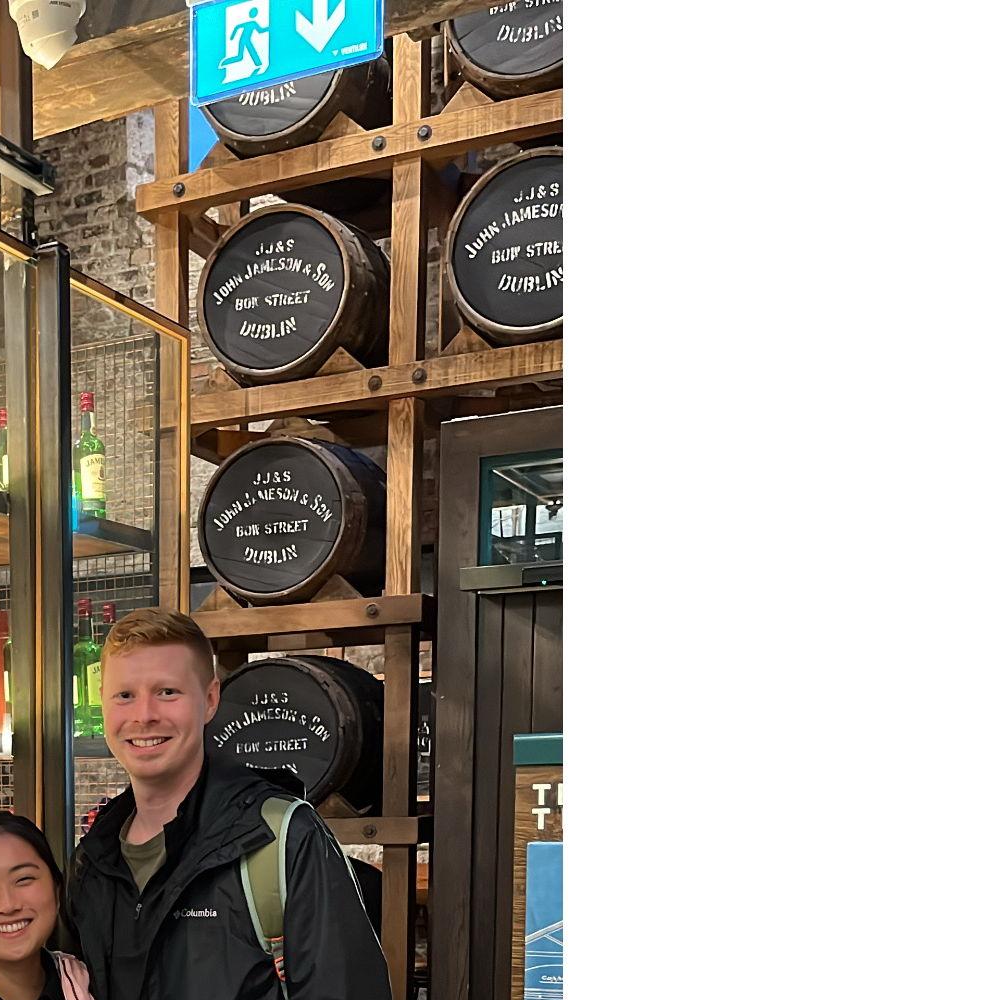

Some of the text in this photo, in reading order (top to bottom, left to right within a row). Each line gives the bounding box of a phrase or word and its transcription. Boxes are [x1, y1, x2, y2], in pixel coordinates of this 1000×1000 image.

[238, 81, 297, 106] DUBLIN
[491, 245, 521, 264] BOW
[212, 257, 335, 305] JOHN JAMESON & SON
[264, 289, 311, 307] STREET
[239, 316, 297, 339] DUBLIN
[213, 500, 243, 531] JOHN
[300, 493, 309, 506] &
[309, 494, 333, 522] SON
[236, 519, 309, 537] BOW STREET
[244, 544, 298, 564] DUBLIN
[213, 720, 243, 748] JOHN
[242, 707, 298, 727] JAMESON
[299, 714, 307, 726] &
[264, 737, 308, 752] STREET
[180, 908, 217, 918] Columbia
